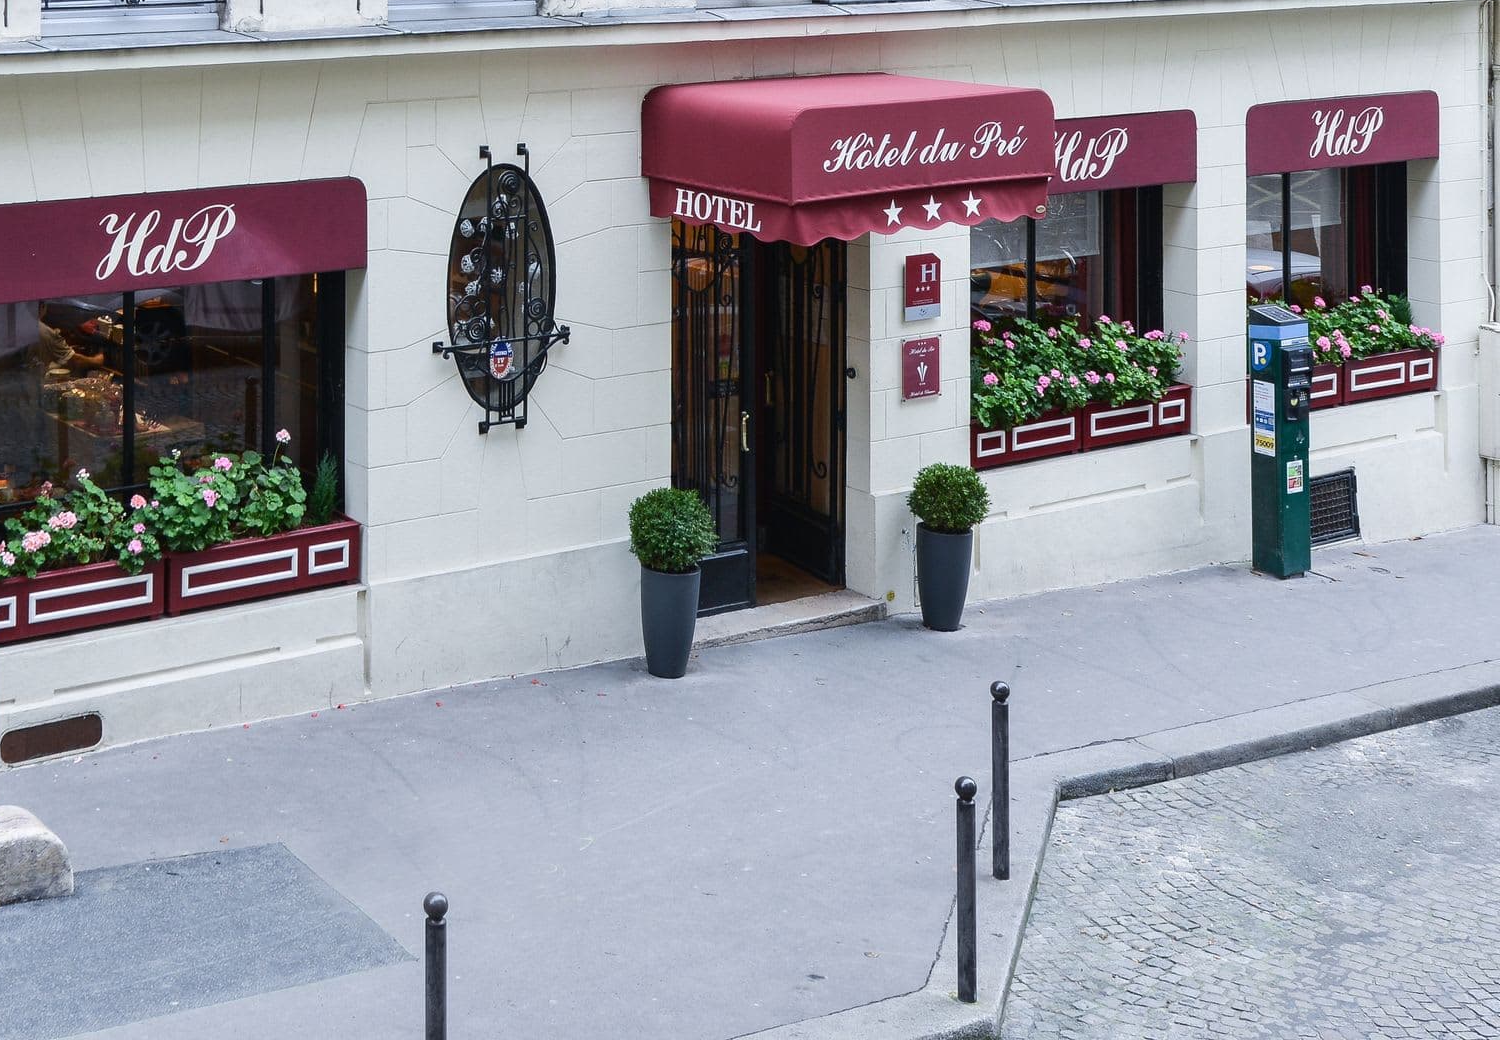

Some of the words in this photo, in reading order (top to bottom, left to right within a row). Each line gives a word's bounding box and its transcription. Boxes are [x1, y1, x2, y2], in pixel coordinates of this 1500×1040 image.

[823, 130, 918, 173] Hôtel
[919, 128, 965, 164] du
[969, 121, 1028, 159] Pré
[1309, 106, 1384, 159] HdP
[673, 188, 762, 233] HOTEL
[95, 203, 236, 281] HdP
[920, 262, 937, 283] H
[1253, 342, 1267, 365] P
